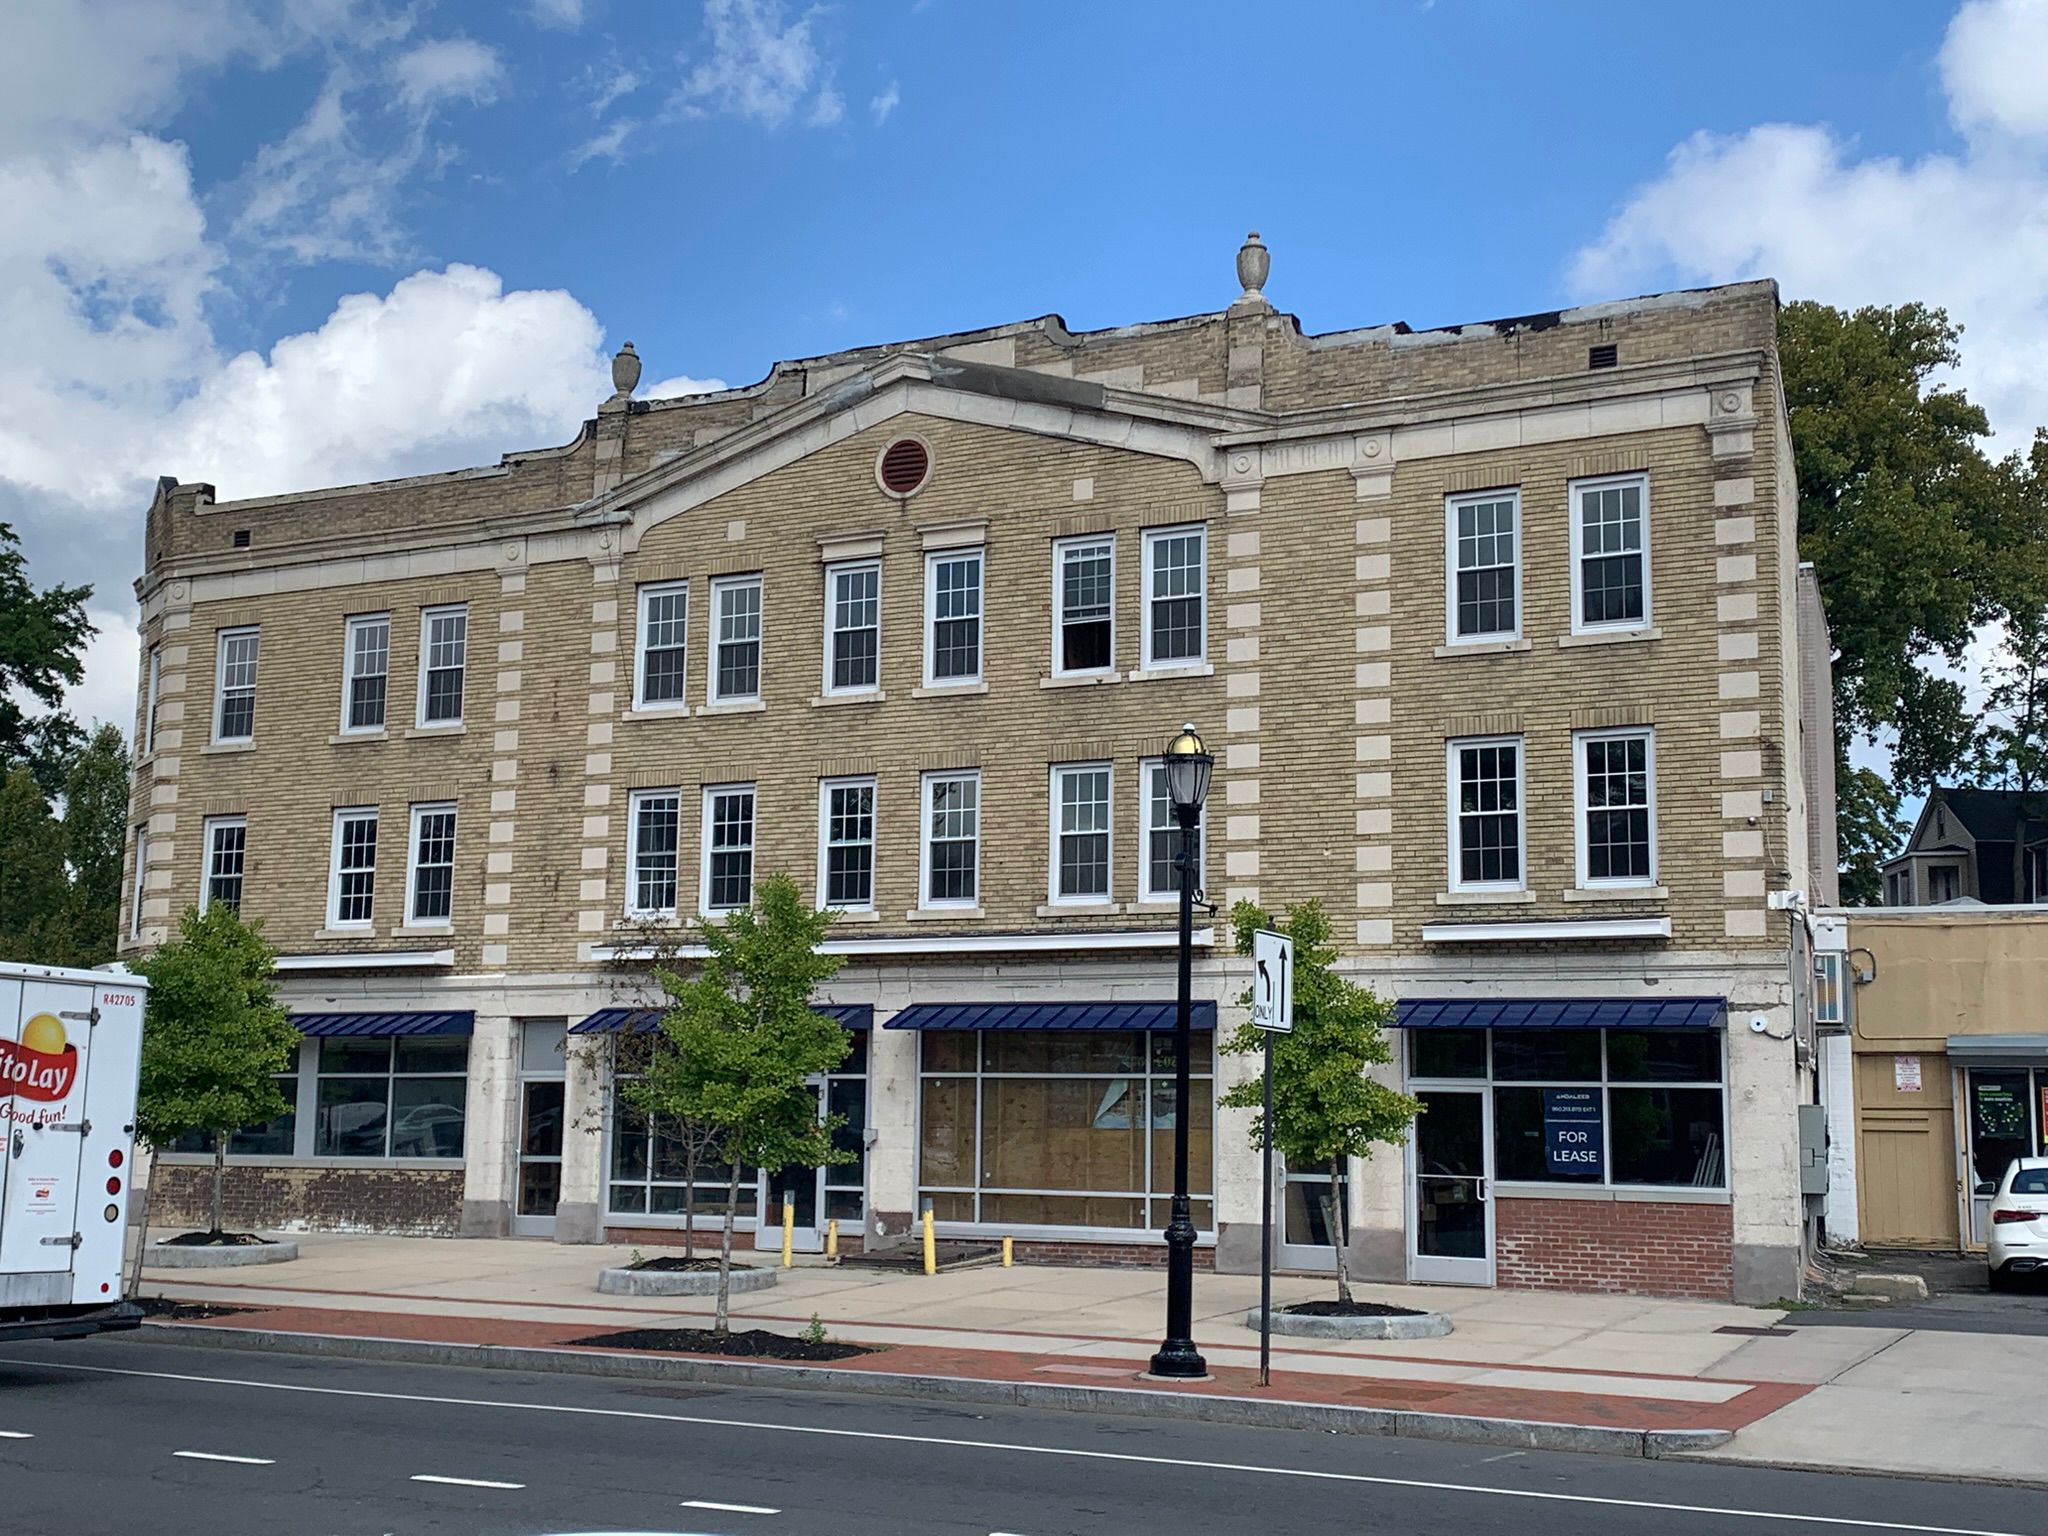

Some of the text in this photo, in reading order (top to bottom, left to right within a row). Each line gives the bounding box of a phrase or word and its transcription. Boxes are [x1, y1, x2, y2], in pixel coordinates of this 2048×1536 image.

[103, 994, 136, 1007] R42705
[1255, 1004, 1272, 1020] ONLY
[0, 1102, 67, 1125] Good fun!
[1558, 1131, 1588, 1143] FOR
[1553, 1150, 1597, 1162] LEASE
